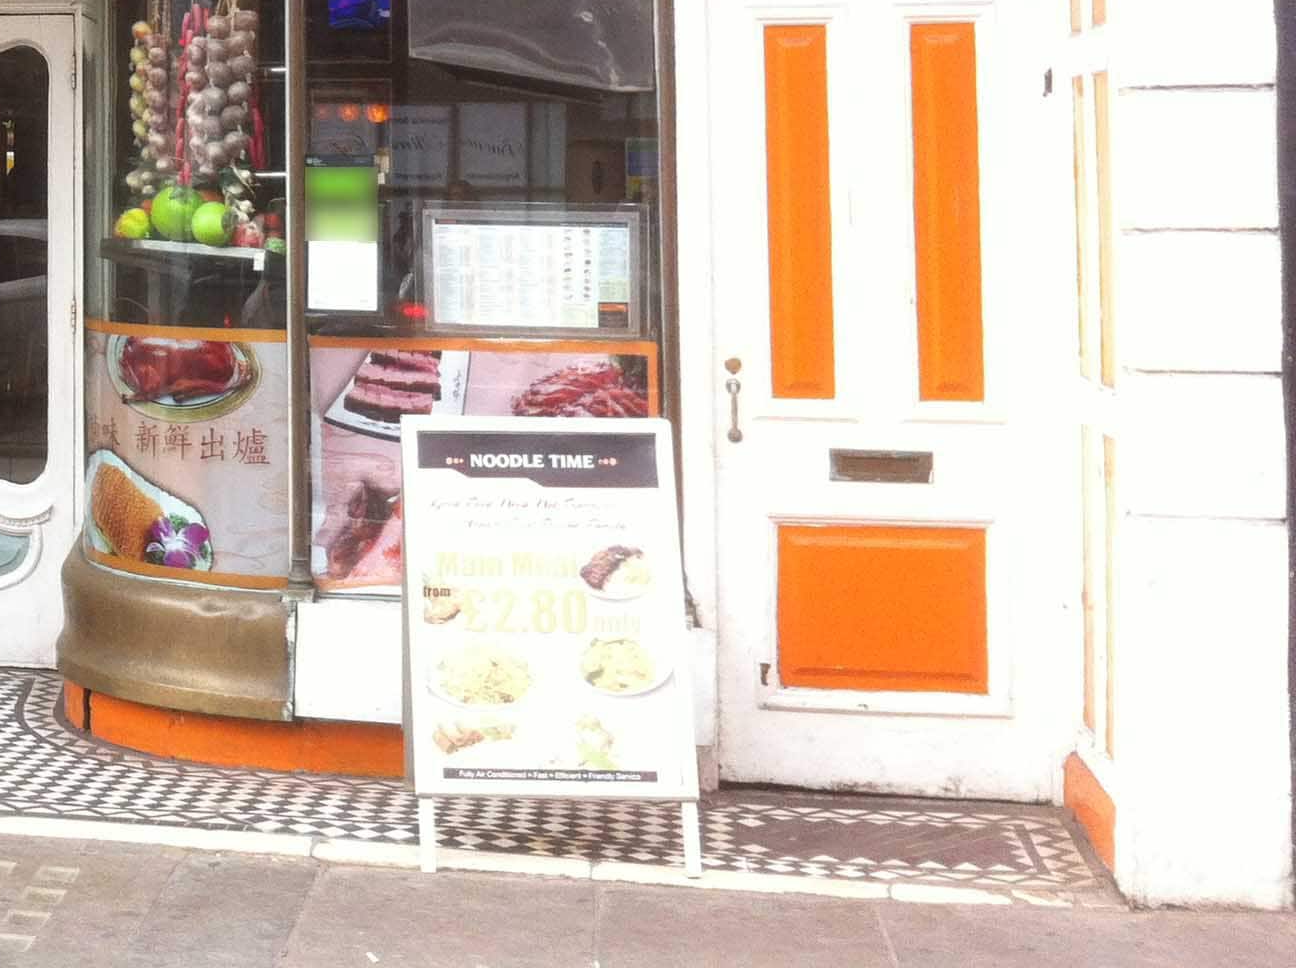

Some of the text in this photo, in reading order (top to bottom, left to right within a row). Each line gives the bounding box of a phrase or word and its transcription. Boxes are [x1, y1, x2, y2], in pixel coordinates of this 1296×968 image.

[136, 420, 270, 465] 新鮮出爐
[470, 453, 595, 469] NOODLE TIME
[422, 584, 451, 598] from
[464, 586, 589, 634] £2.80
